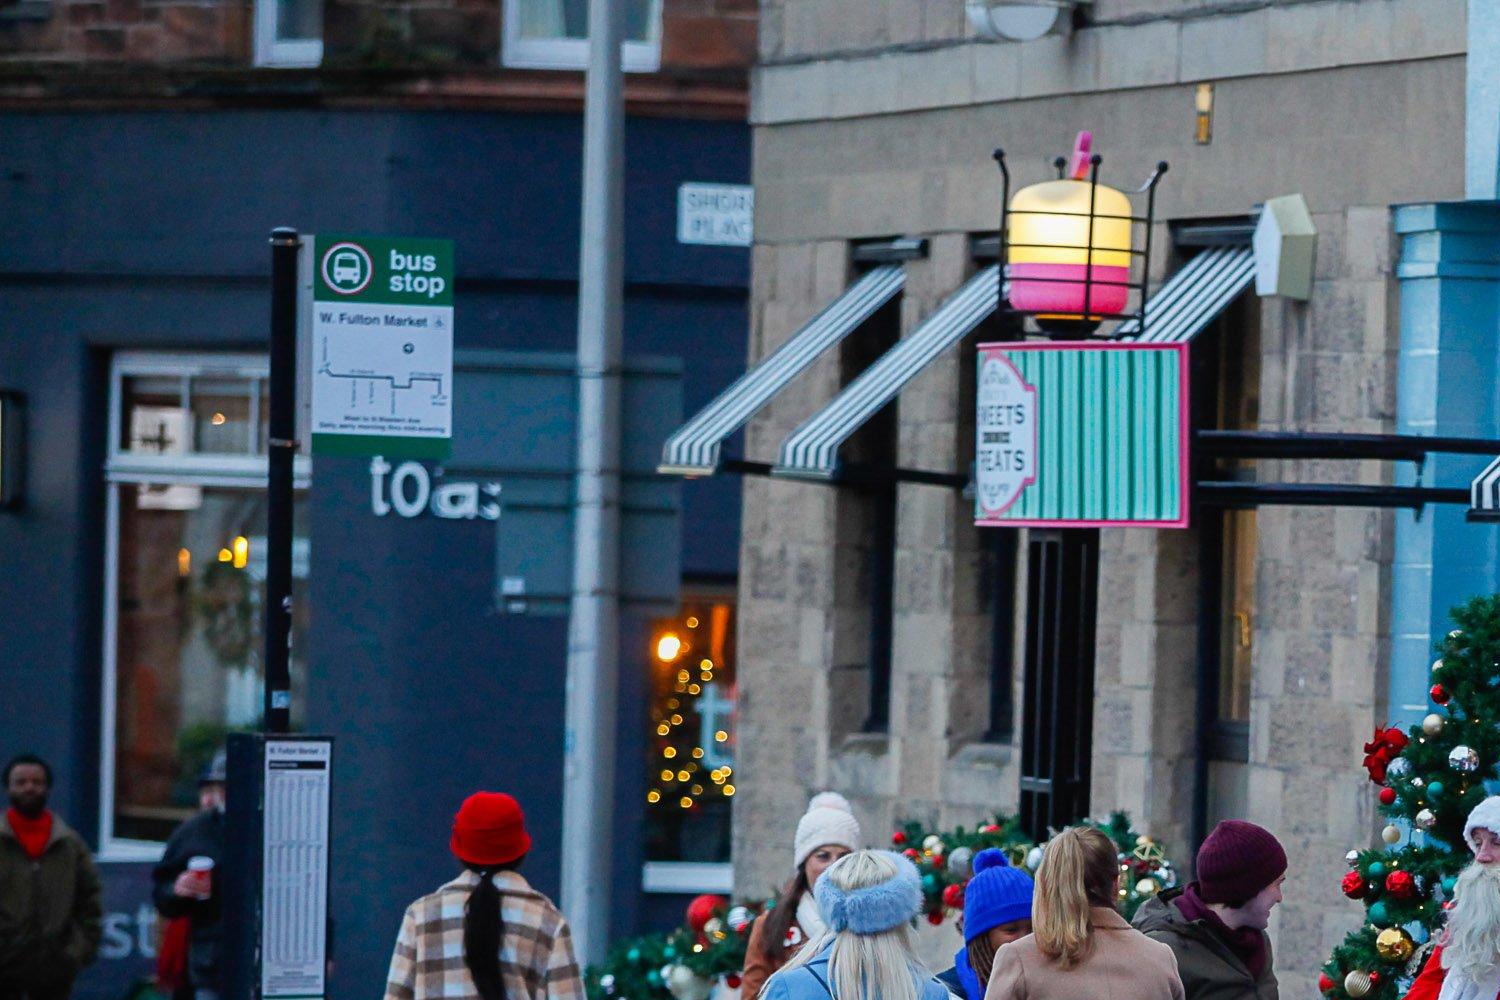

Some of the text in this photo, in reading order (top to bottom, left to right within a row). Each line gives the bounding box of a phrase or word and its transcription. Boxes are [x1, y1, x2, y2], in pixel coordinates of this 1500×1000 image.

[390, 250, 437, 272] bus
[390, 272, 446, 298] stop
[319, 311, 428, 328] W. Fulton Market
